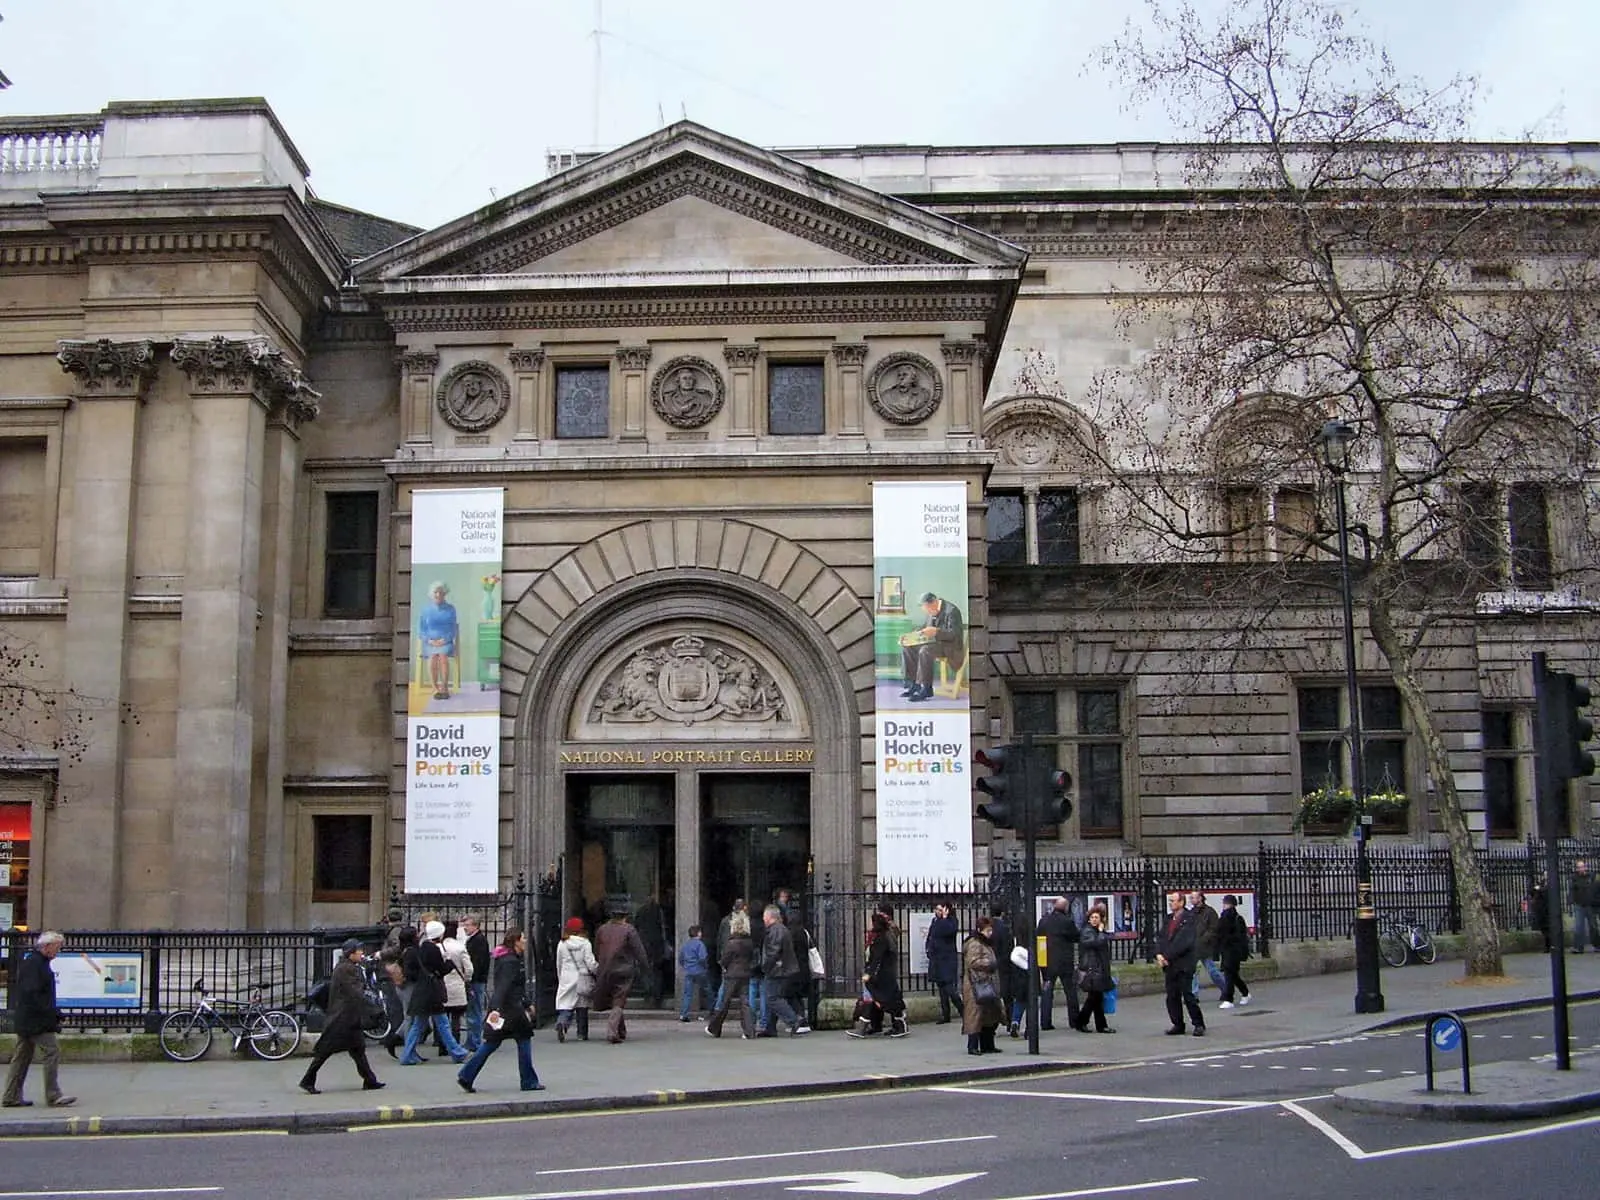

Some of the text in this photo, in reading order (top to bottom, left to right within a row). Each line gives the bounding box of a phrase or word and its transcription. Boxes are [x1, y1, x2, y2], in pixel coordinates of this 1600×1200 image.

[461, 510, 497, 519] National
[924, 504, 960, 512] National
[461, 520, 497, 530] Portrait
[924, 514, 960, 523] Portrait
[461, 531, 497, 541] Gallery
[924, 524, 960, 536] Gallery
[416, 724, 464, 740] David
[884, 721, 934, 737] David
[416, 743, 492, 760] Hockney
[884, 740, 962, 757] Hockney
[560, 750, 815, 763] NATIONAL PORTRAIT GALLERY
[415, 761, 492, 776] Portraits
[884, 757, 963, 773] Portraits
